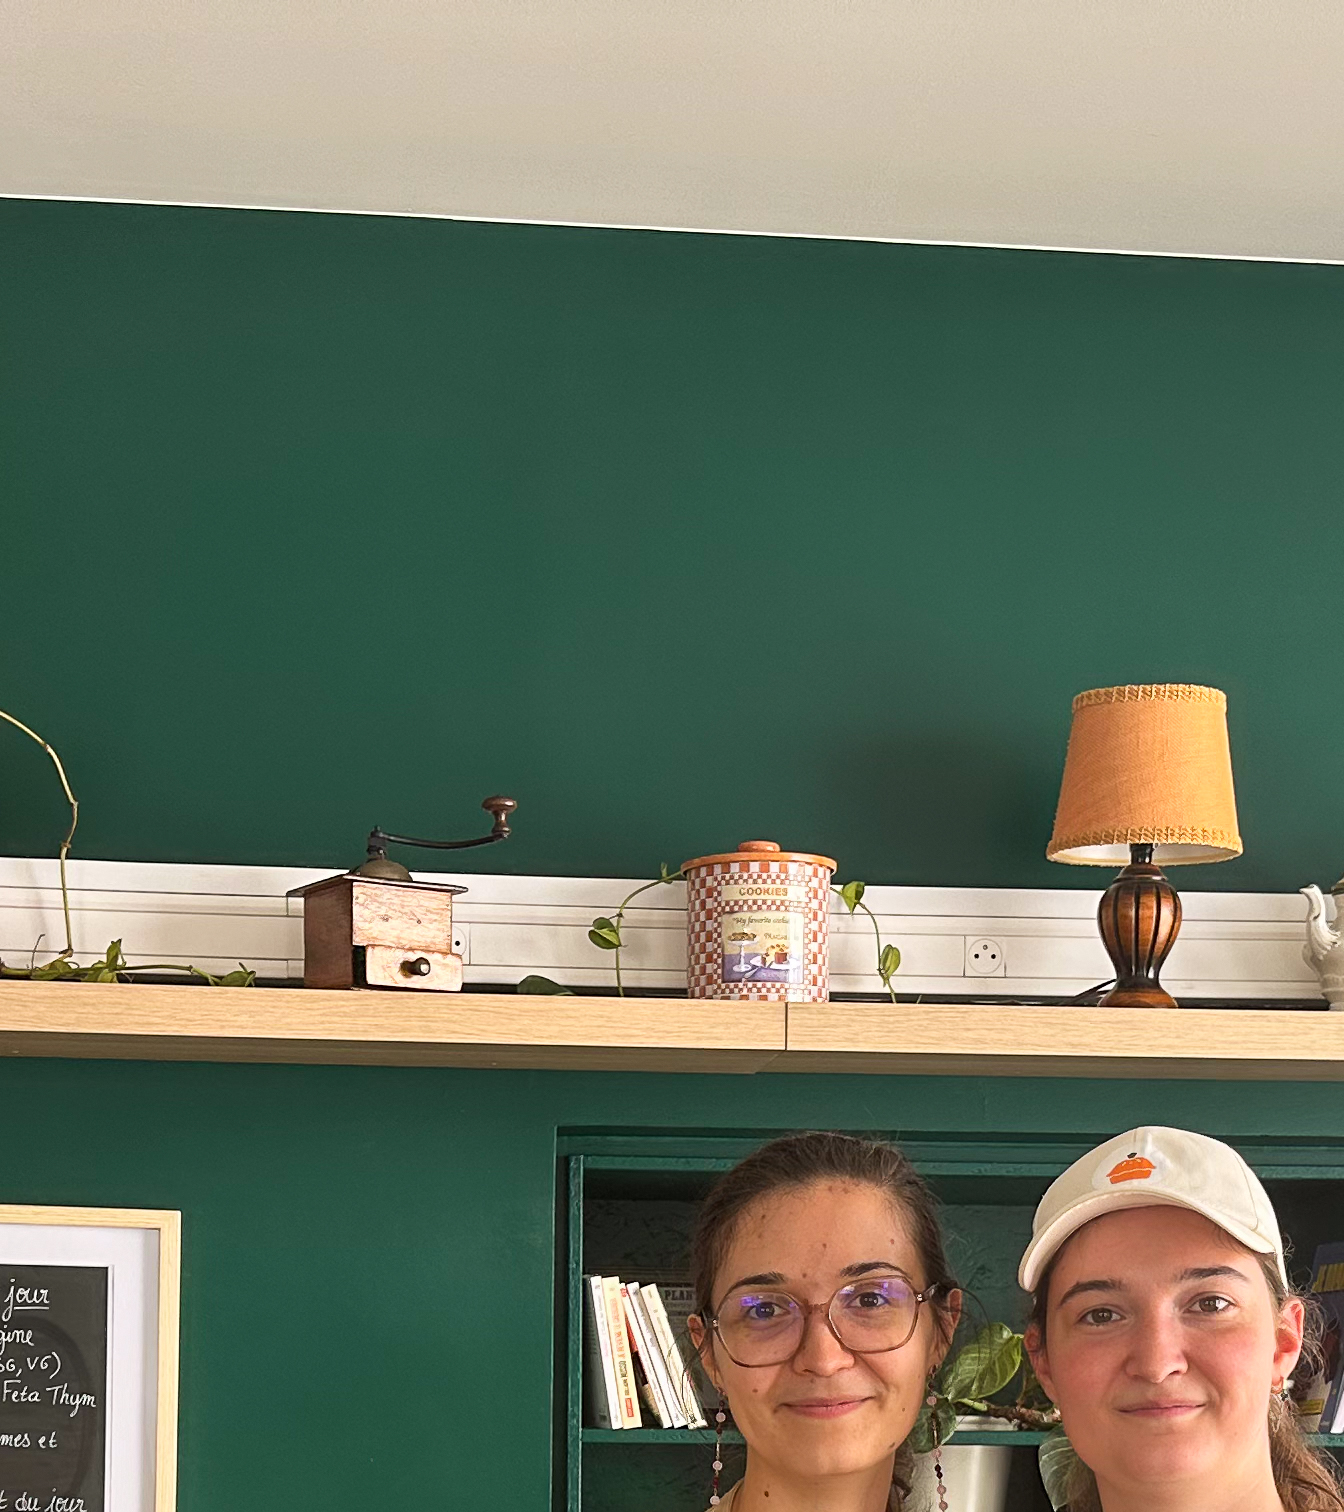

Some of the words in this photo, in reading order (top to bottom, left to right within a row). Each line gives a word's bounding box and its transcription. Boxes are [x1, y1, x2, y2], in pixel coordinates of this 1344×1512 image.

[739, 887, 788, 897] COOKIES
[2, 1279, 50, 1321] jour
[2, 1379, 42, 1403] Feta
[45, 1383, 97, 1417] Thym
[38, 1431, 58, 1448] et
[14, 1491, 41, 1512] du
